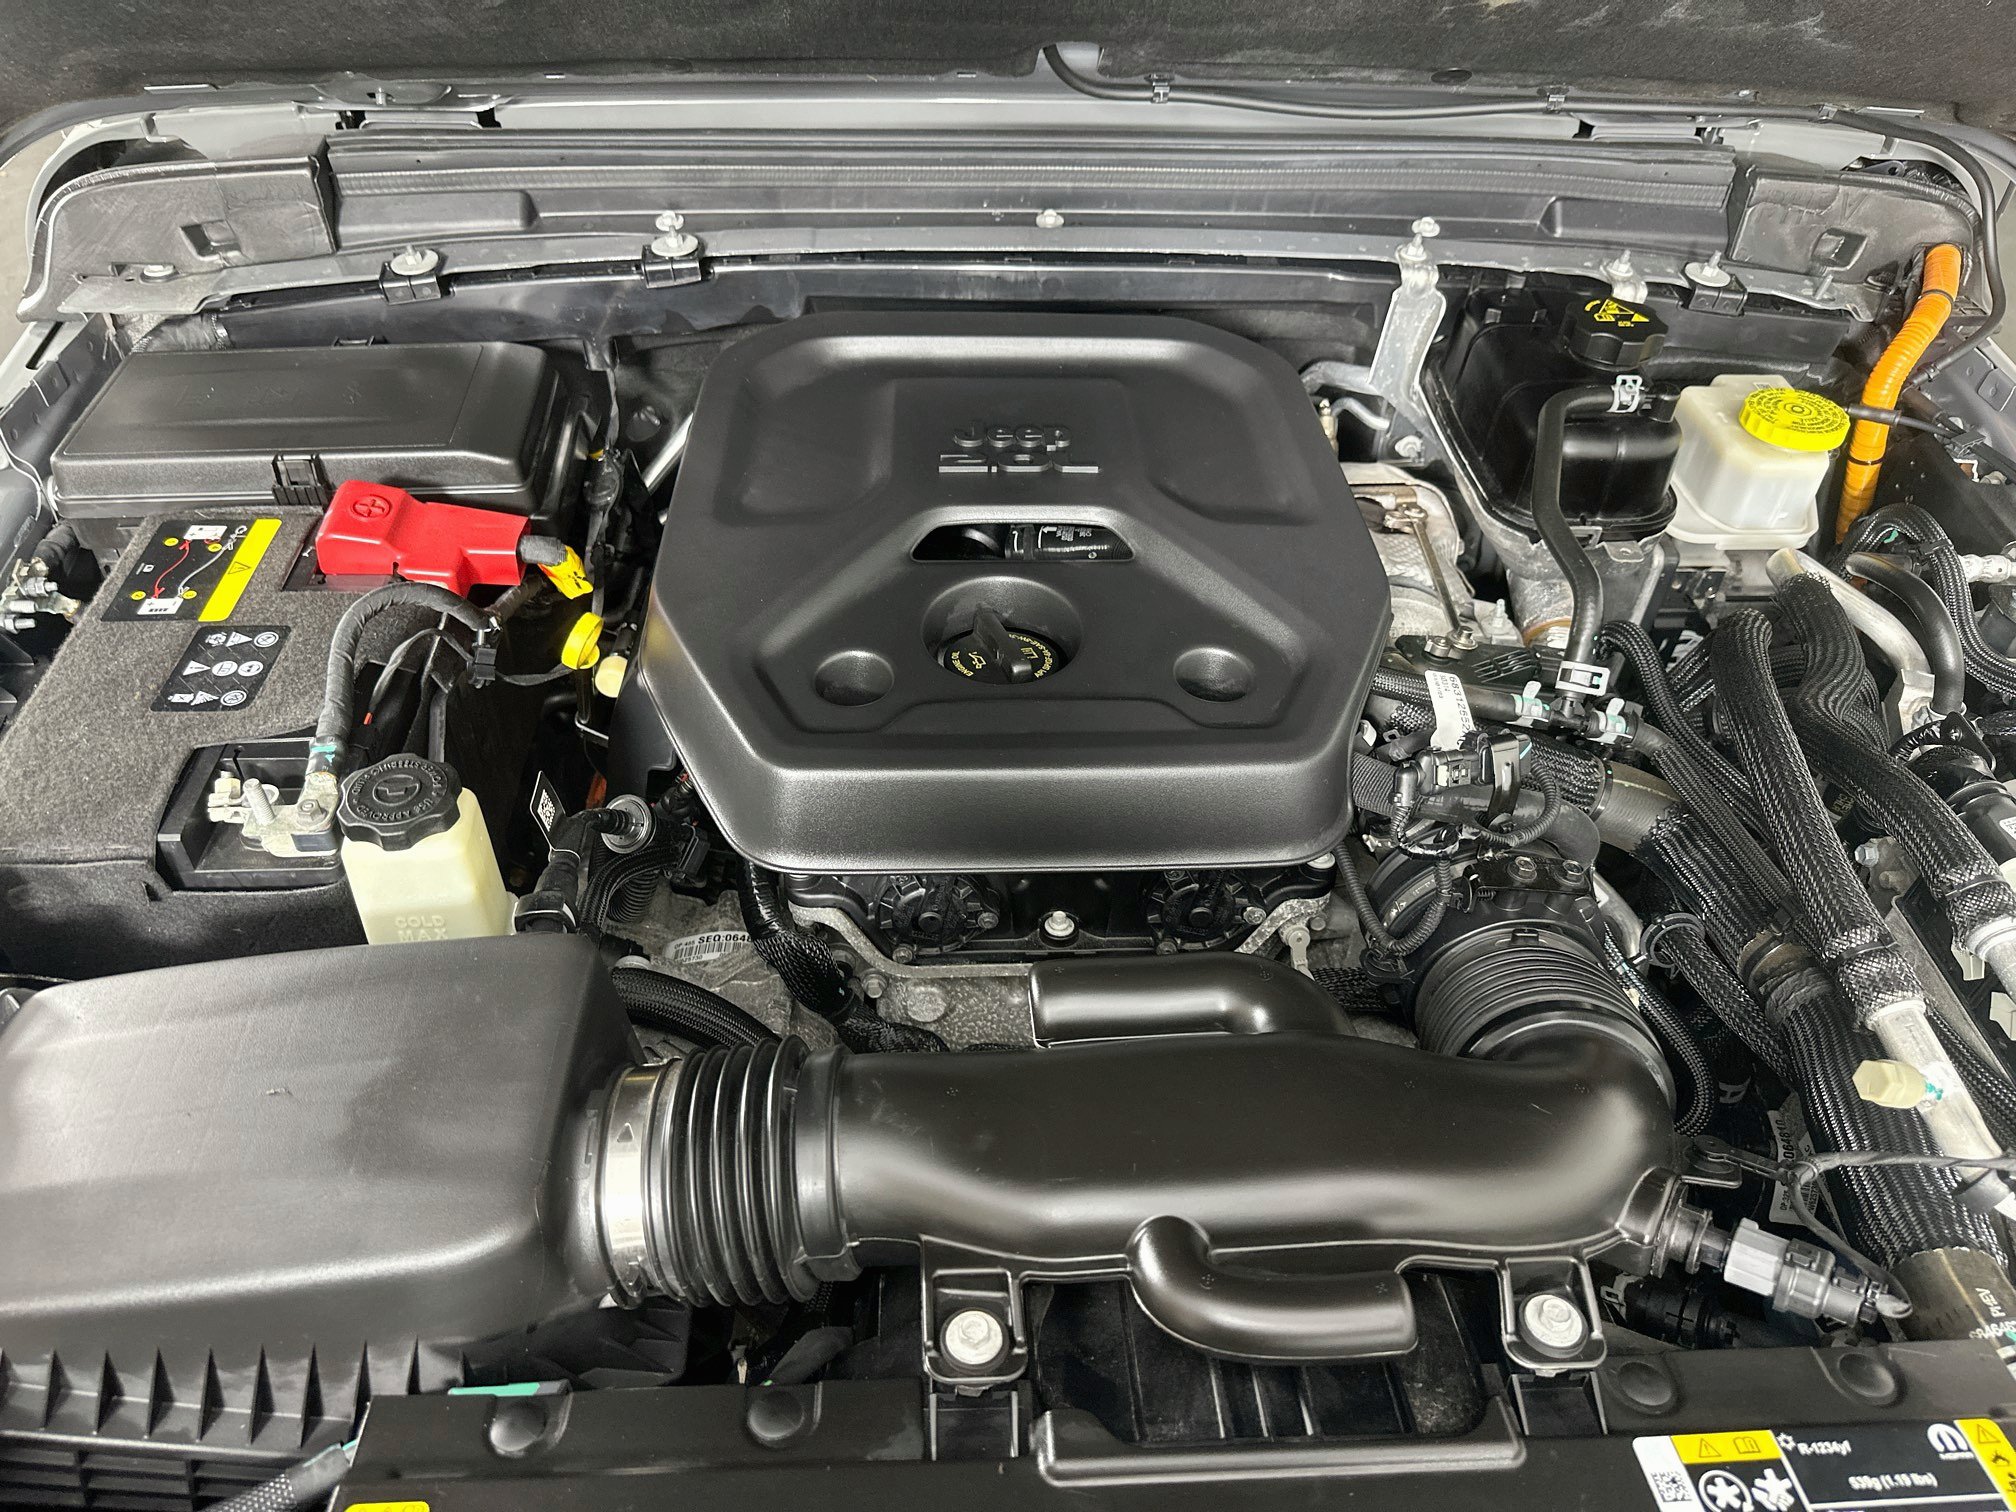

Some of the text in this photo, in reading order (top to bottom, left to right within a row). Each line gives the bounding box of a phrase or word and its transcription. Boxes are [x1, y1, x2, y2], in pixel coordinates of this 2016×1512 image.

[953, 420, 1072, 452] Jeep
[937, 451, 1100, 474] 2.0L
[951, 658, 975, 677] ENGINE
[370, 759, 421, 776] STEERING
[421, 763, 442, 788] POWER
[356, 797, 434, 822] USE APPROVED
[394, 915, 446, 928] COLD
[397, 928, 449, 942] MAX
[1975, 1287, 2006, 1318] PHEV
